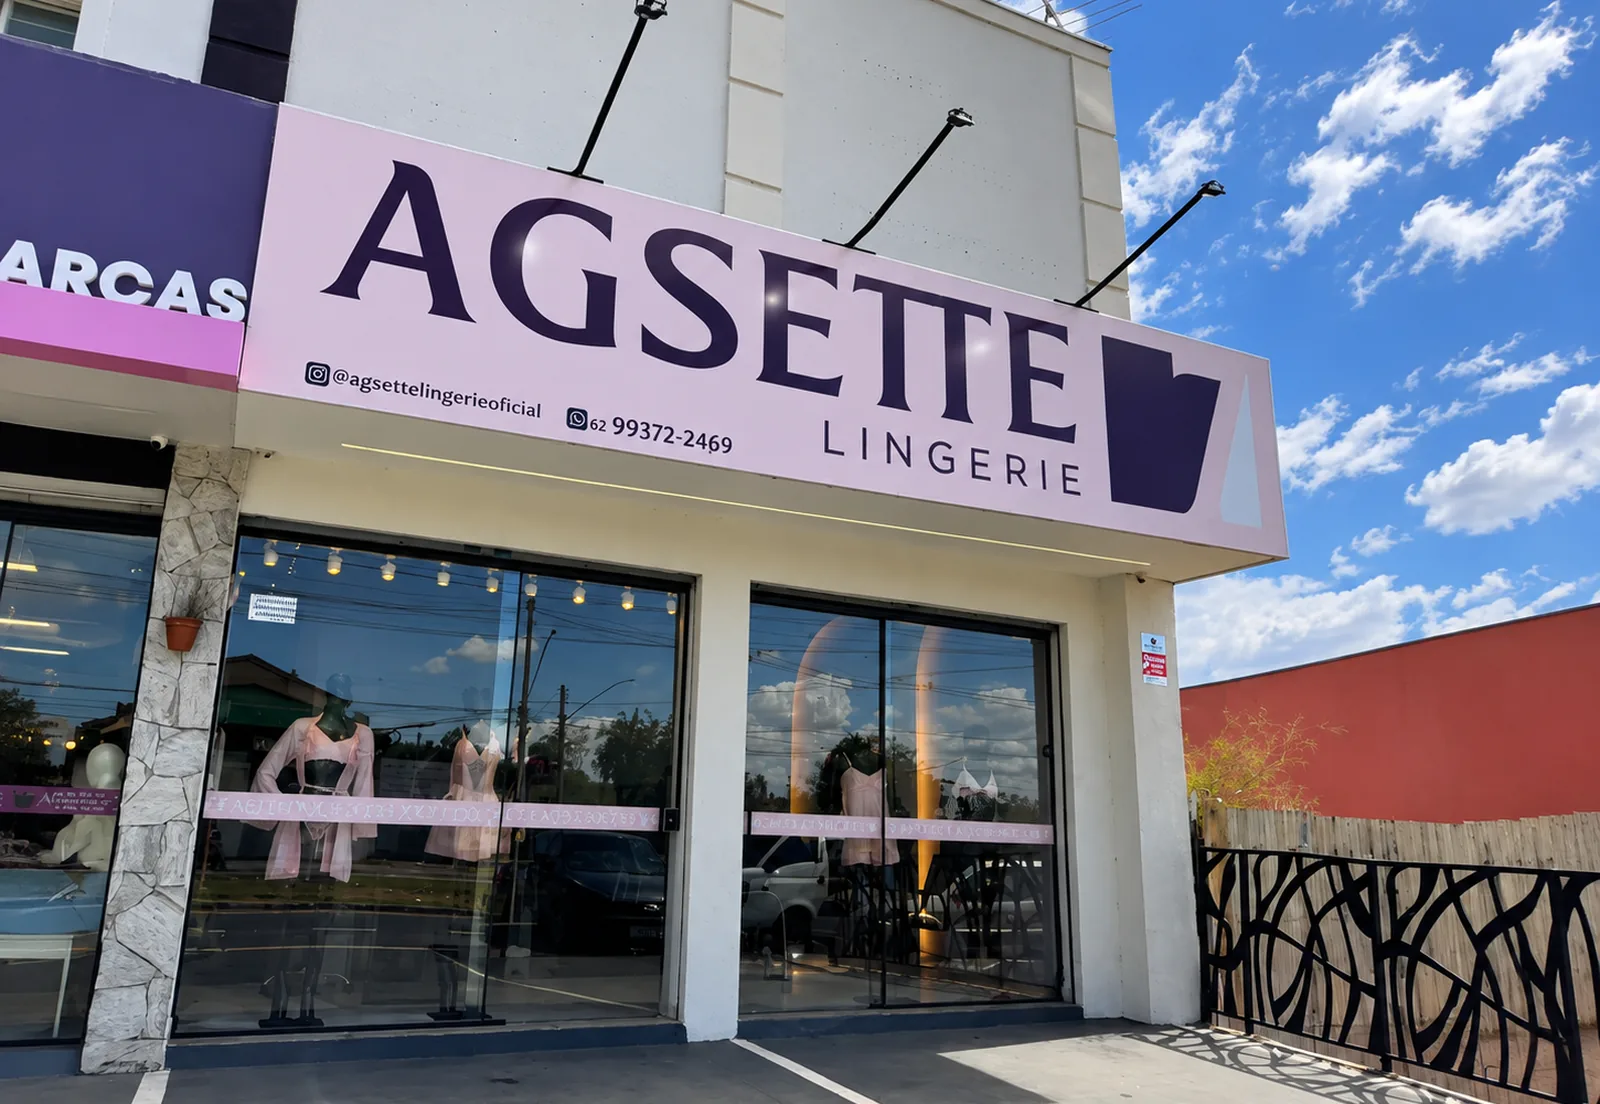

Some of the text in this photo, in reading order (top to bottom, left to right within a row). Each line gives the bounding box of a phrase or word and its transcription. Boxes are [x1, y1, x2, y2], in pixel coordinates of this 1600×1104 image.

[0, 239, 248, 323] ARCAS
[320, 160, 1077, 445] AGSETTE
[332, 368, 542, 418] @agsettelingerieoficial
[589, 416, 733, 454] 62 99372-2469
[823, 419, 1082, 497] LINGERIE
